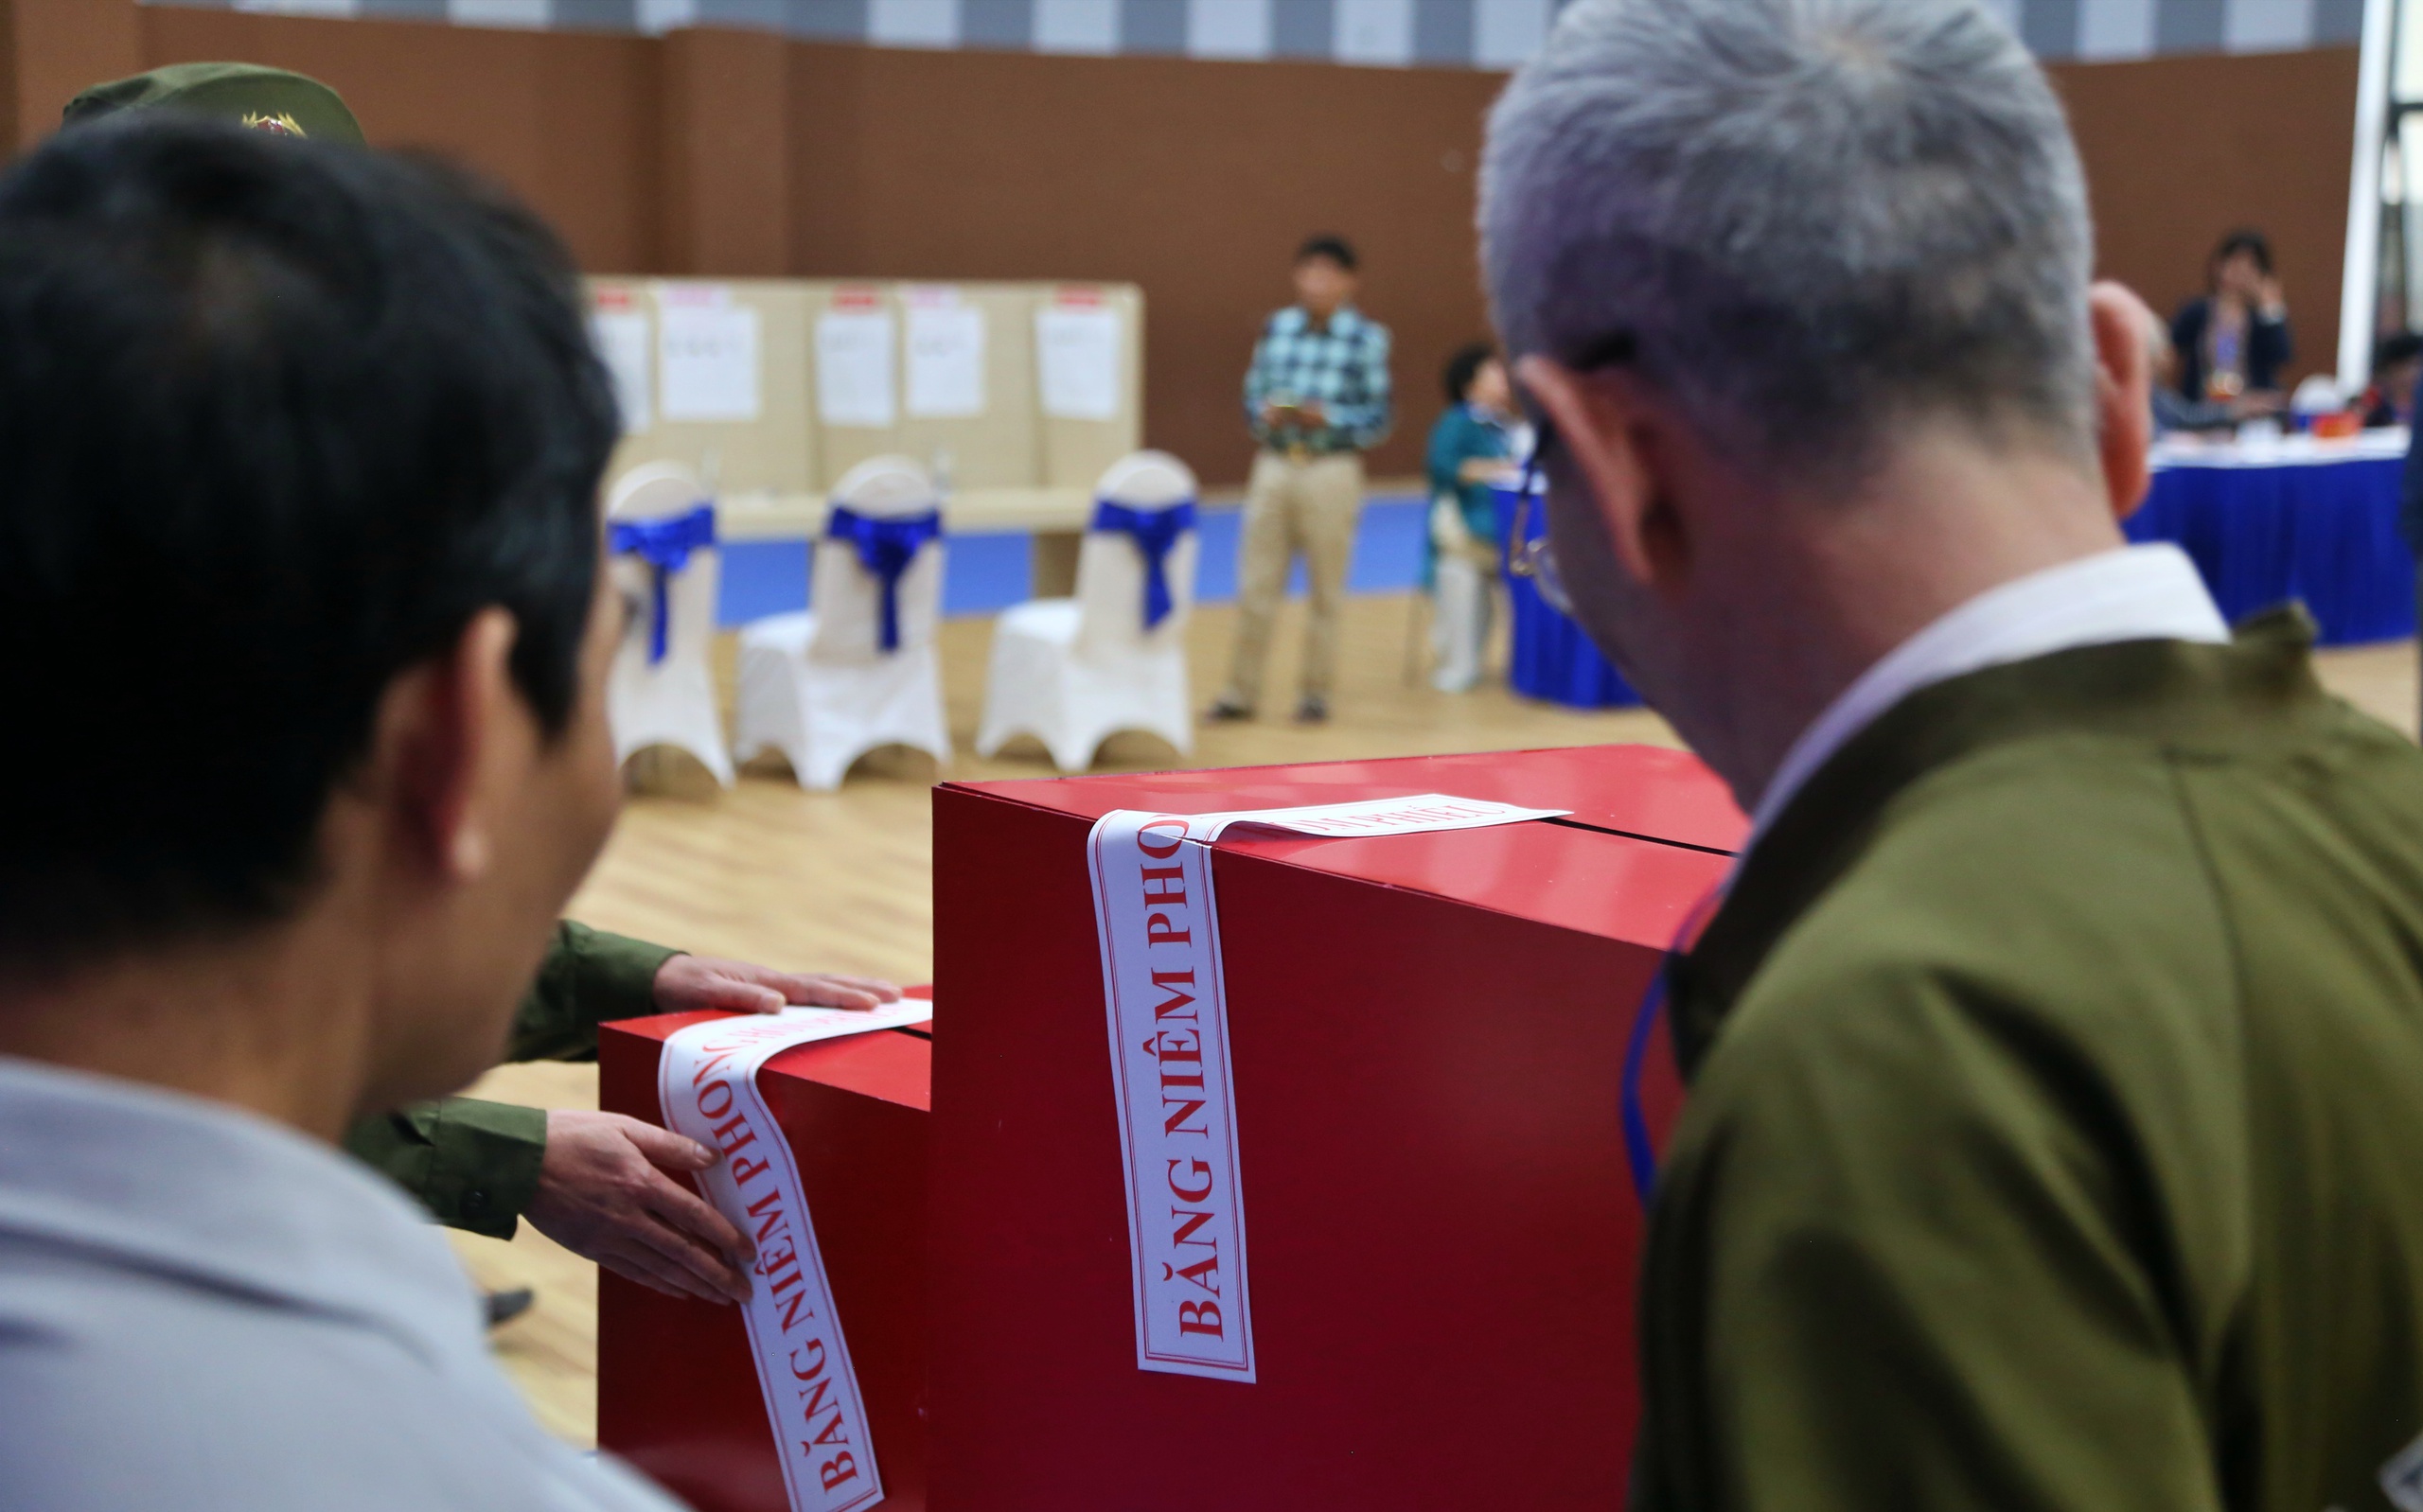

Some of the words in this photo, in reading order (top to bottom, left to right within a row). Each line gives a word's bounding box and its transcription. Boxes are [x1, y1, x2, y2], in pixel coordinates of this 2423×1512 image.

[1137, 818, 1192, 950] PHO
[1142, 965, 1209, 1139] NIÊM
[746, 1185, 815, 1336] NIÊM
[1161, 1155, 1224, 1343] BĂNG
[789, 1337, 859, 1495] BĂNG
